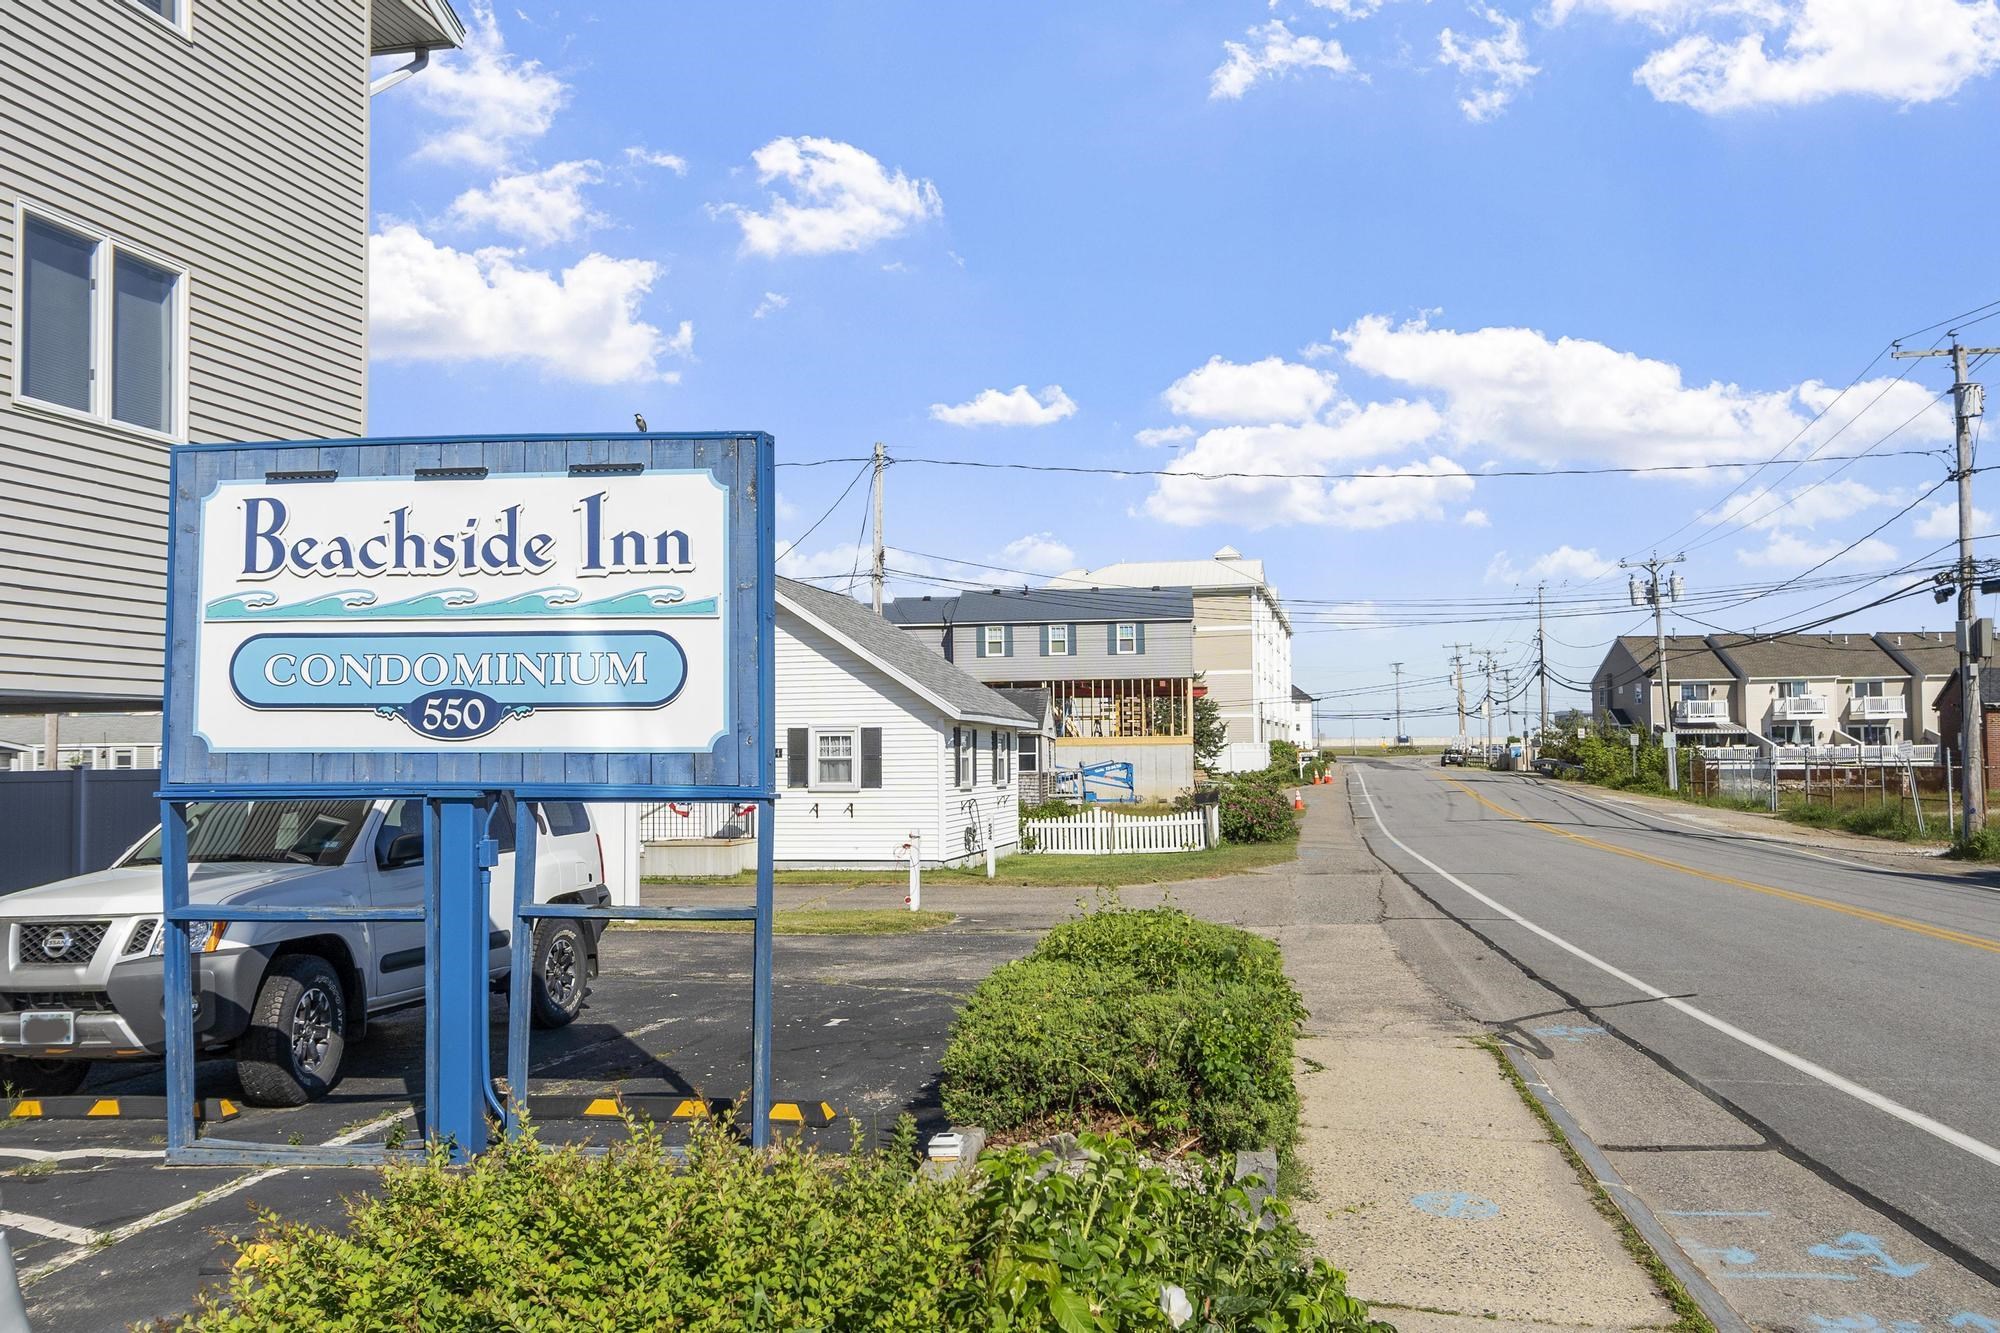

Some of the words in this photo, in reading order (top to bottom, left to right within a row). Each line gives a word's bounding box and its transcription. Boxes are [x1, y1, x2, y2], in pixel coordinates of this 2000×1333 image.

[242, 496, 556, 574] Beachside
[577, 490, 692, 571] Inn
[263, 652, 647, 687] CONDOMINIUM
[422, 697, 486, 731] 550
